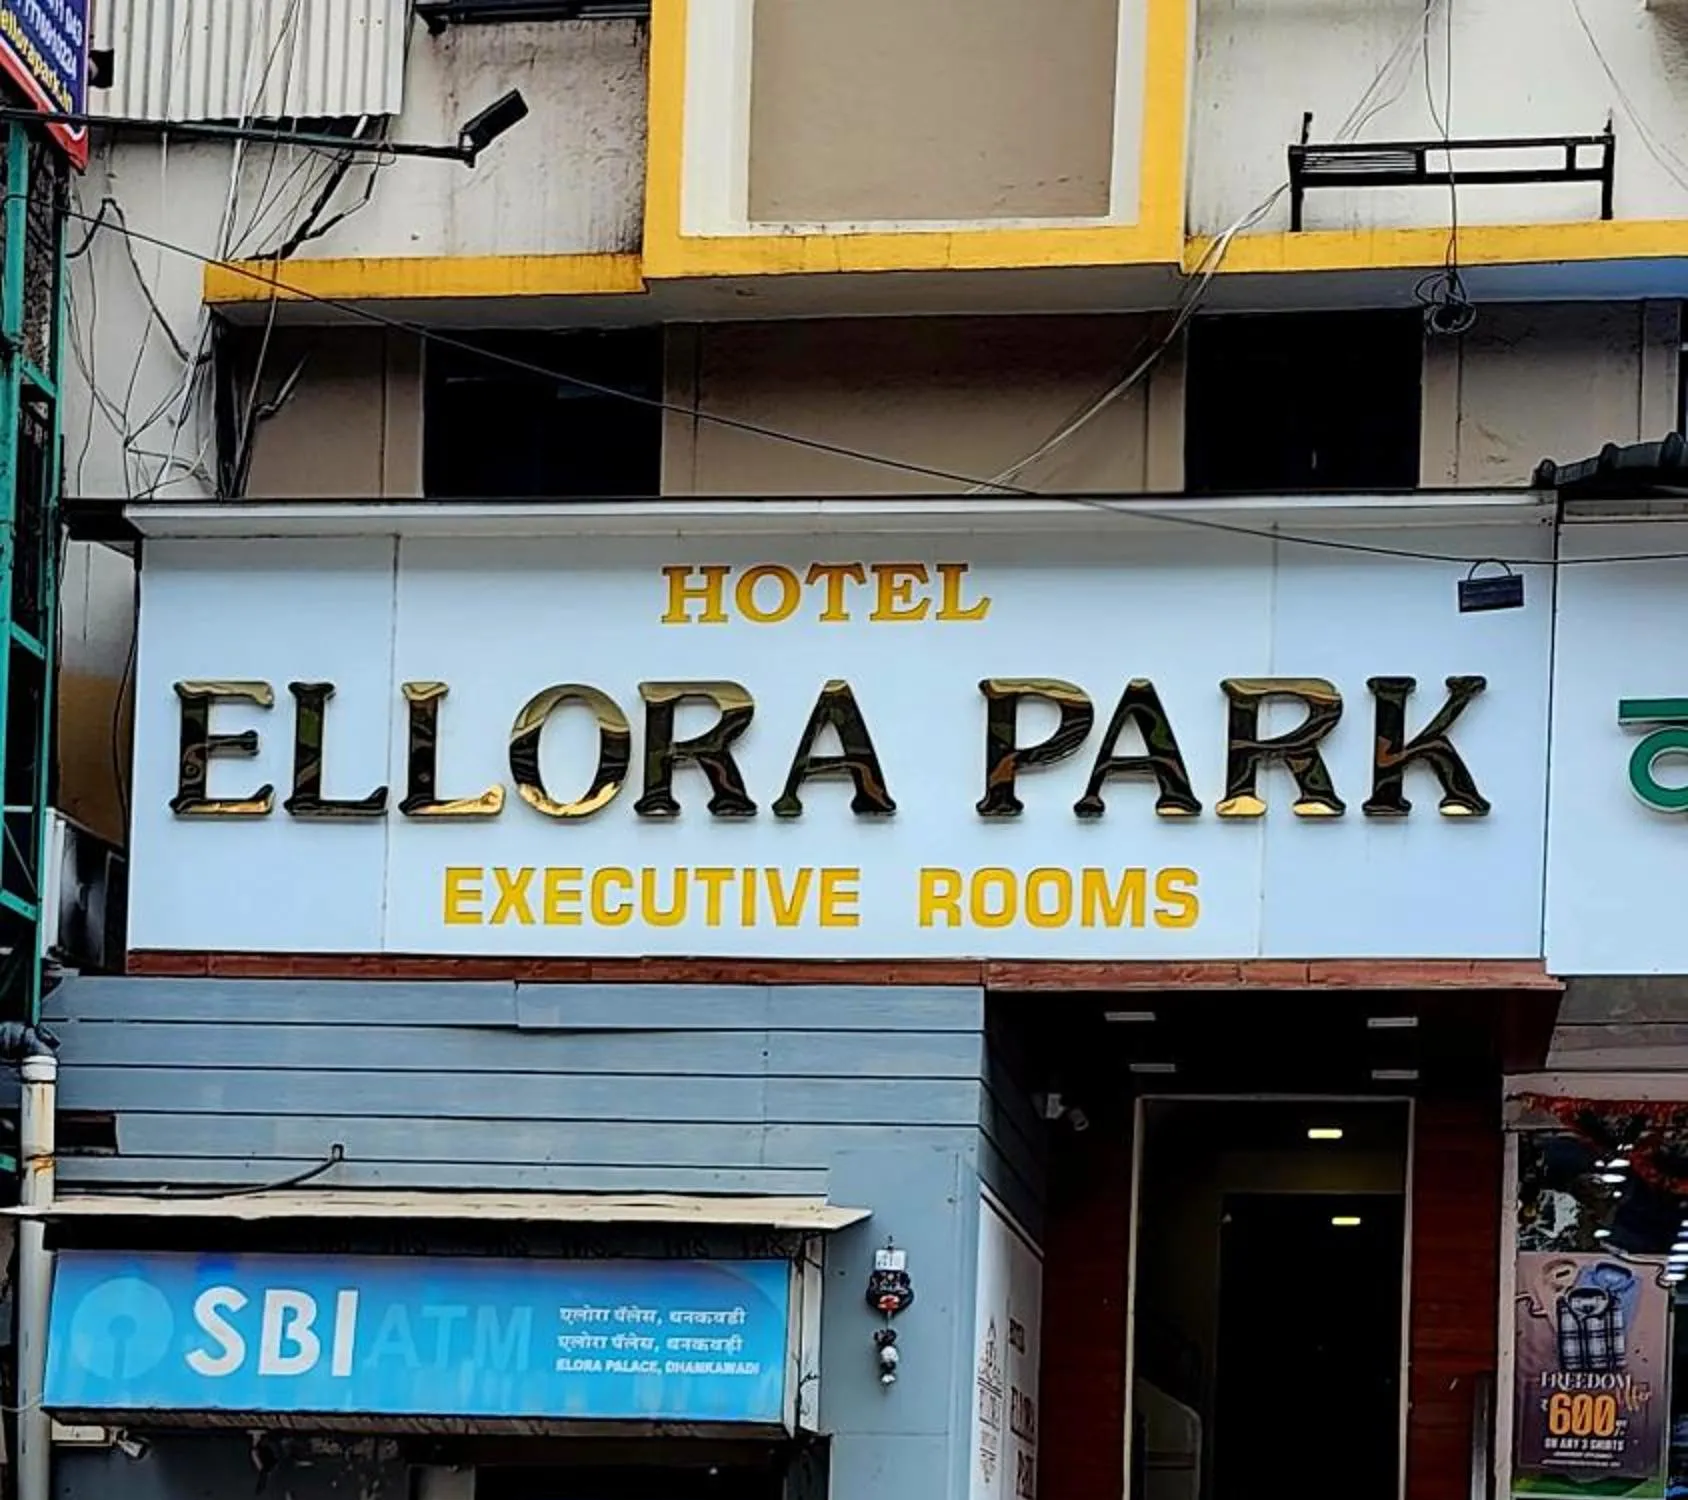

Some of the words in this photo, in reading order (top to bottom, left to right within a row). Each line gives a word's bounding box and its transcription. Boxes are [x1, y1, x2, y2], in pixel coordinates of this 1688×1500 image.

[662, 563, 990, 624] HOTEL
[168, 679, 897, 818] ELLORA
[975, 675, 1491, 819] PARK
[443, 866, 860, 927] EXECUTIVE
[919, 867, 1200, 928] ROOMS
[184, 1285, 360, 1377] SBI
[362, 1303, 533, 1372] ATM
[556, 1358, 602, 1372] ELORA
[1540, 1371, 1631, 1391] FREEDOM
